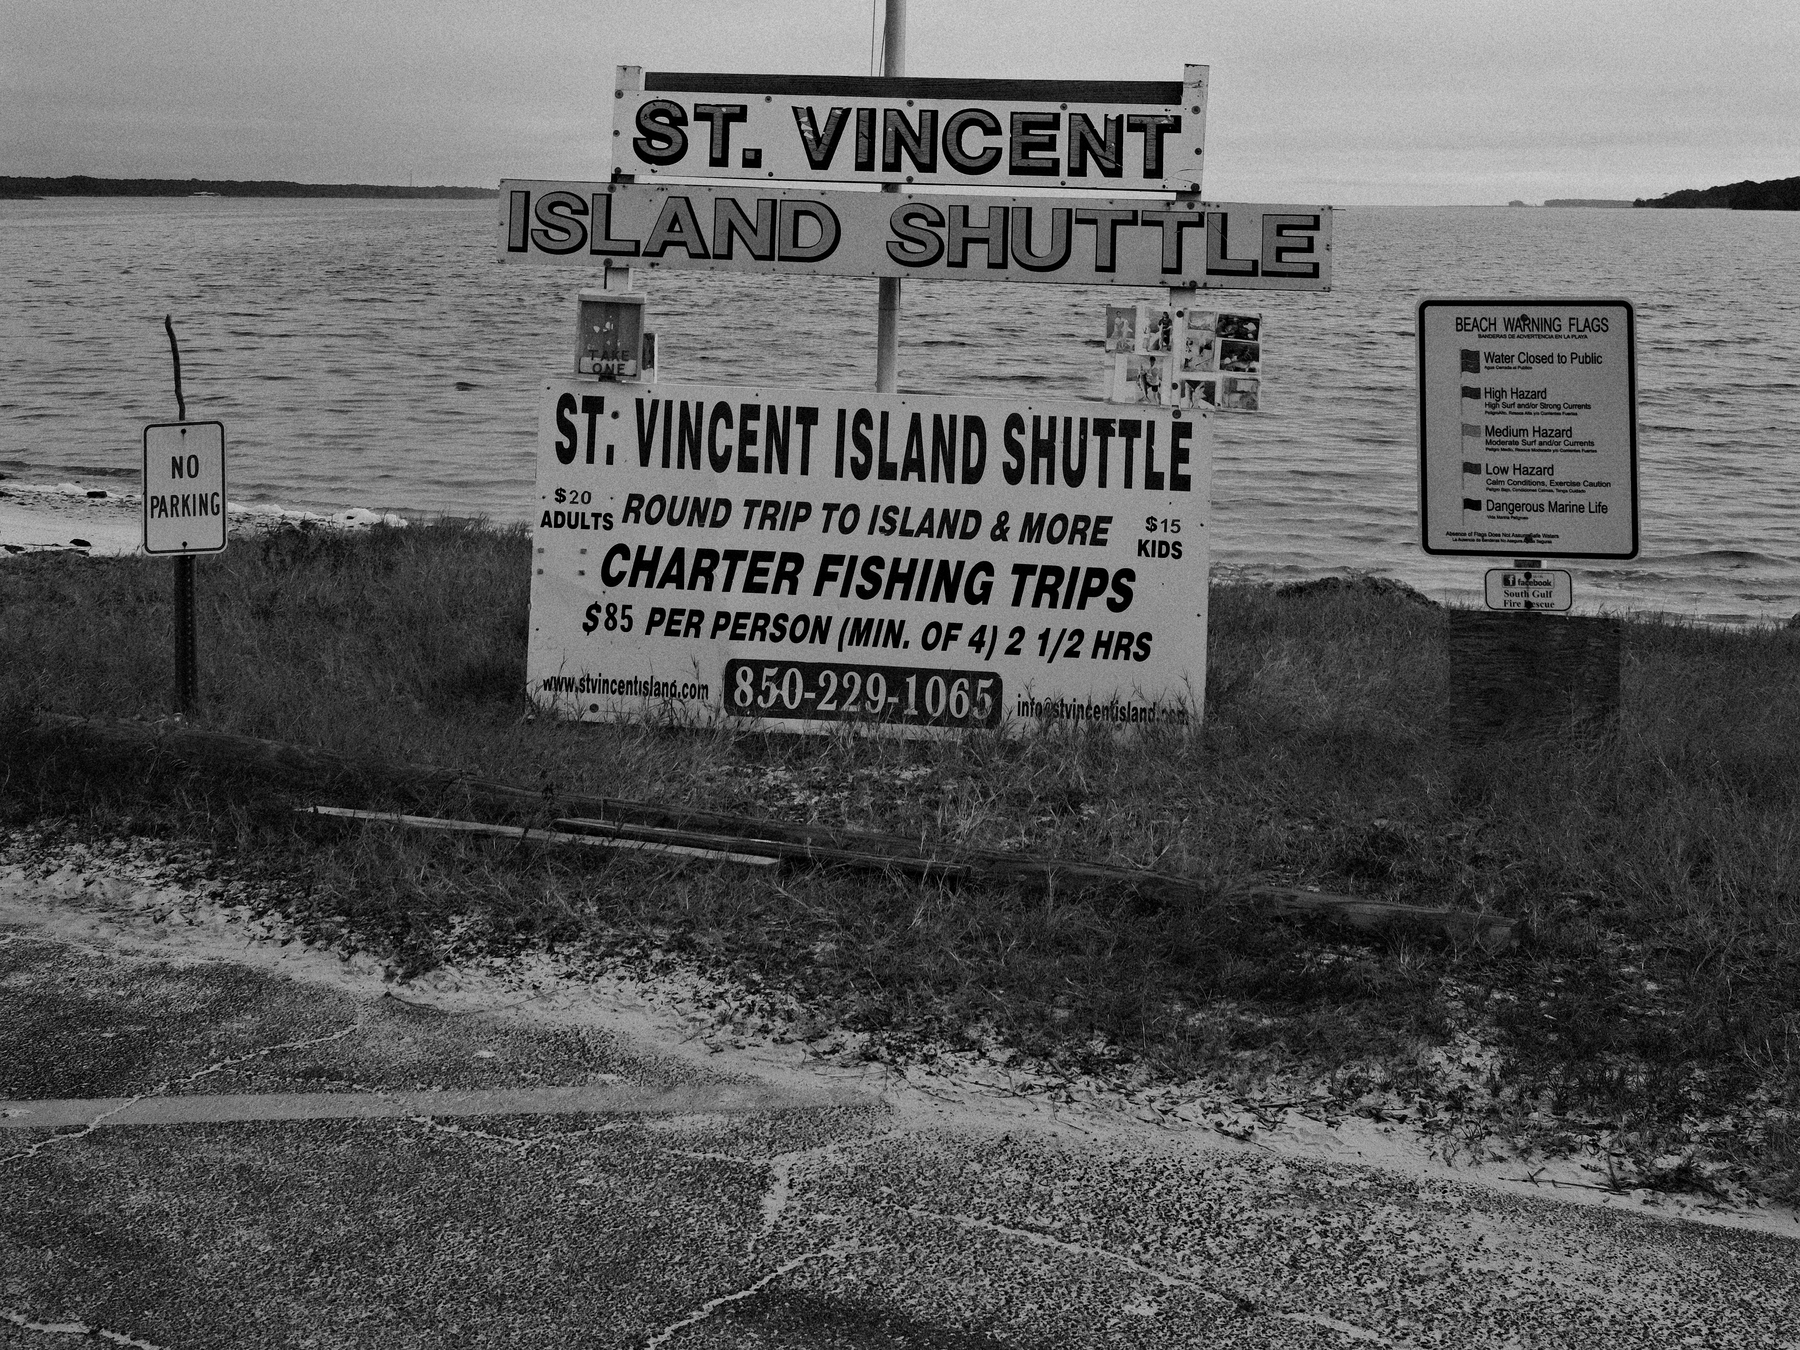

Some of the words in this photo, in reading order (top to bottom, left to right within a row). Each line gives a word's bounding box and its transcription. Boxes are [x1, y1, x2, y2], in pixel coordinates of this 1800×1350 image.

[632, 98, 763, 168] ST.
[791, 104, 1182, 179] VINCENT
[507, 189, 842, 264] ISLAND
[886, 202, 1321, 279] SHUTTLE
[1455, 317, 1497, 332] BEACH
[1503, 317, 1562, 332] WARNING
[1568, 317, 1609, 333] FLAGS
[588, 350, 630, 361] TAKE
[1484, 351, 1515, 364] Water
[1518, 351, 1554, 364] Closed
[1557, 352, 1567, 364] to
[1570, 352, 1603, 364] Public
[592, 363, 626, 375] ONE
[1484, 387, 1507, 402] High
[1510, 387, 1547, 400] Hazard
[1484, 402, 1500, 410] High
[1540, 402, 1561, 411] Strong
[1562, 402, 1592, 410] Currents
[1484, 425, 1529, 438] Medium
[1532, 426, 1573, 438] Hazard
[554, 392, 615, 466] ST.
[635, 397, 819, 476] VINCENT
[834, 406, 987, 486] ISLAND
[1002, 412, 1193, 492] SHUTTLE
[1485, 438, 1520, 446] Moderate
[1563, 439, 1595, 447] Currents
[171, 454, 199, 479] NO
[1485, 463, 1509, 475] Low
[1512, 463, 1554, 476] Hazard
[1485, 478, 1505, 486] Calm
[1507, 479, 1547, 487] Conditions,
[1549, 479, 1581, 487] Exercise
[1582, 480, 1611, 488] Caution
[554, 487, 592, 505] $20
[150, 492, 220, 519] PARKING
[1486, 499, 1545, 515] Dangerous
[1548, 500, 1585, 513] Marine
[1588, 501, 1608, 514] Life
[540, 510, 614, 531] ADULTS
[621, 492, 733, 529] ROUND
[743, 498, 812, 532] TRIP
[821, 502, 860, 535] TO
[867, 504, 983, 541] ISLAND
[989, 510, 1010, 542] &
[1018, 511, 1113, 547] MORE
[1145, 515, 1182, 534] $15
[1137, 539, 1183, 560] KIDS
[600, 542, 805, 596] CHARTER
[812, 553, 995, 606] FISHING
[1010, 563, 1137, 613] TRIPS
[1517, 578, 1552, 587] facebook
[1503, 590, 1530, 598] South
[1532, 590, 1553, 598] Gulf
[1503, 599, 1521, 607] Fire
[582, 601, 634, 636] $85
[645, 607, 705, 639] PER
[710, 610, 833, 645] PERSON
[837, 616, 910, 653] (MIN.
[921, 620, 963, 652] OF
[968, 624, 998, 661] 4)
[1004, 625, 1026, 656] 2
[1038, 627, 1085, 664] 1/2
[1091, 629, 1153, 662] HRS
[543, 672, 709, 700] www.stvincentisland.com
[733, 666, 994, 720] 850-229-1065
